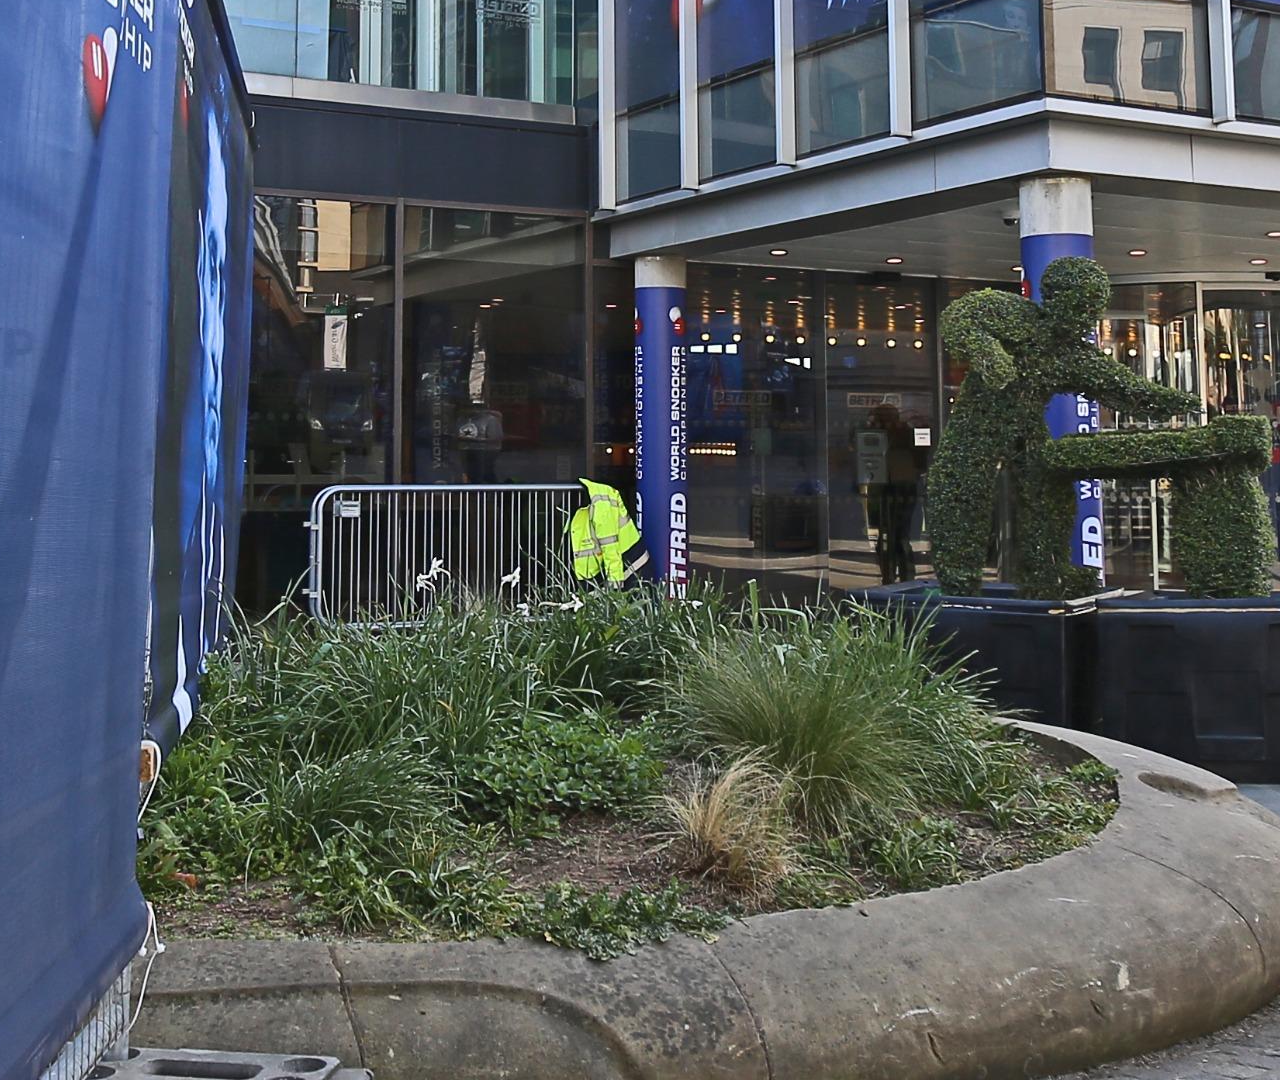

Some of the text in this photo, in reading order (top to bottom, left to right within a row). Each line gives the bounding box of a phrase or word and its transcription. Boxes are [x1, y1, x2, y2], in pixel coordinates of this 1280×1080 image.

[670, 345, 681, 481] WORLD SNOOKER
[670, 492, 688, 600] ETFRED
